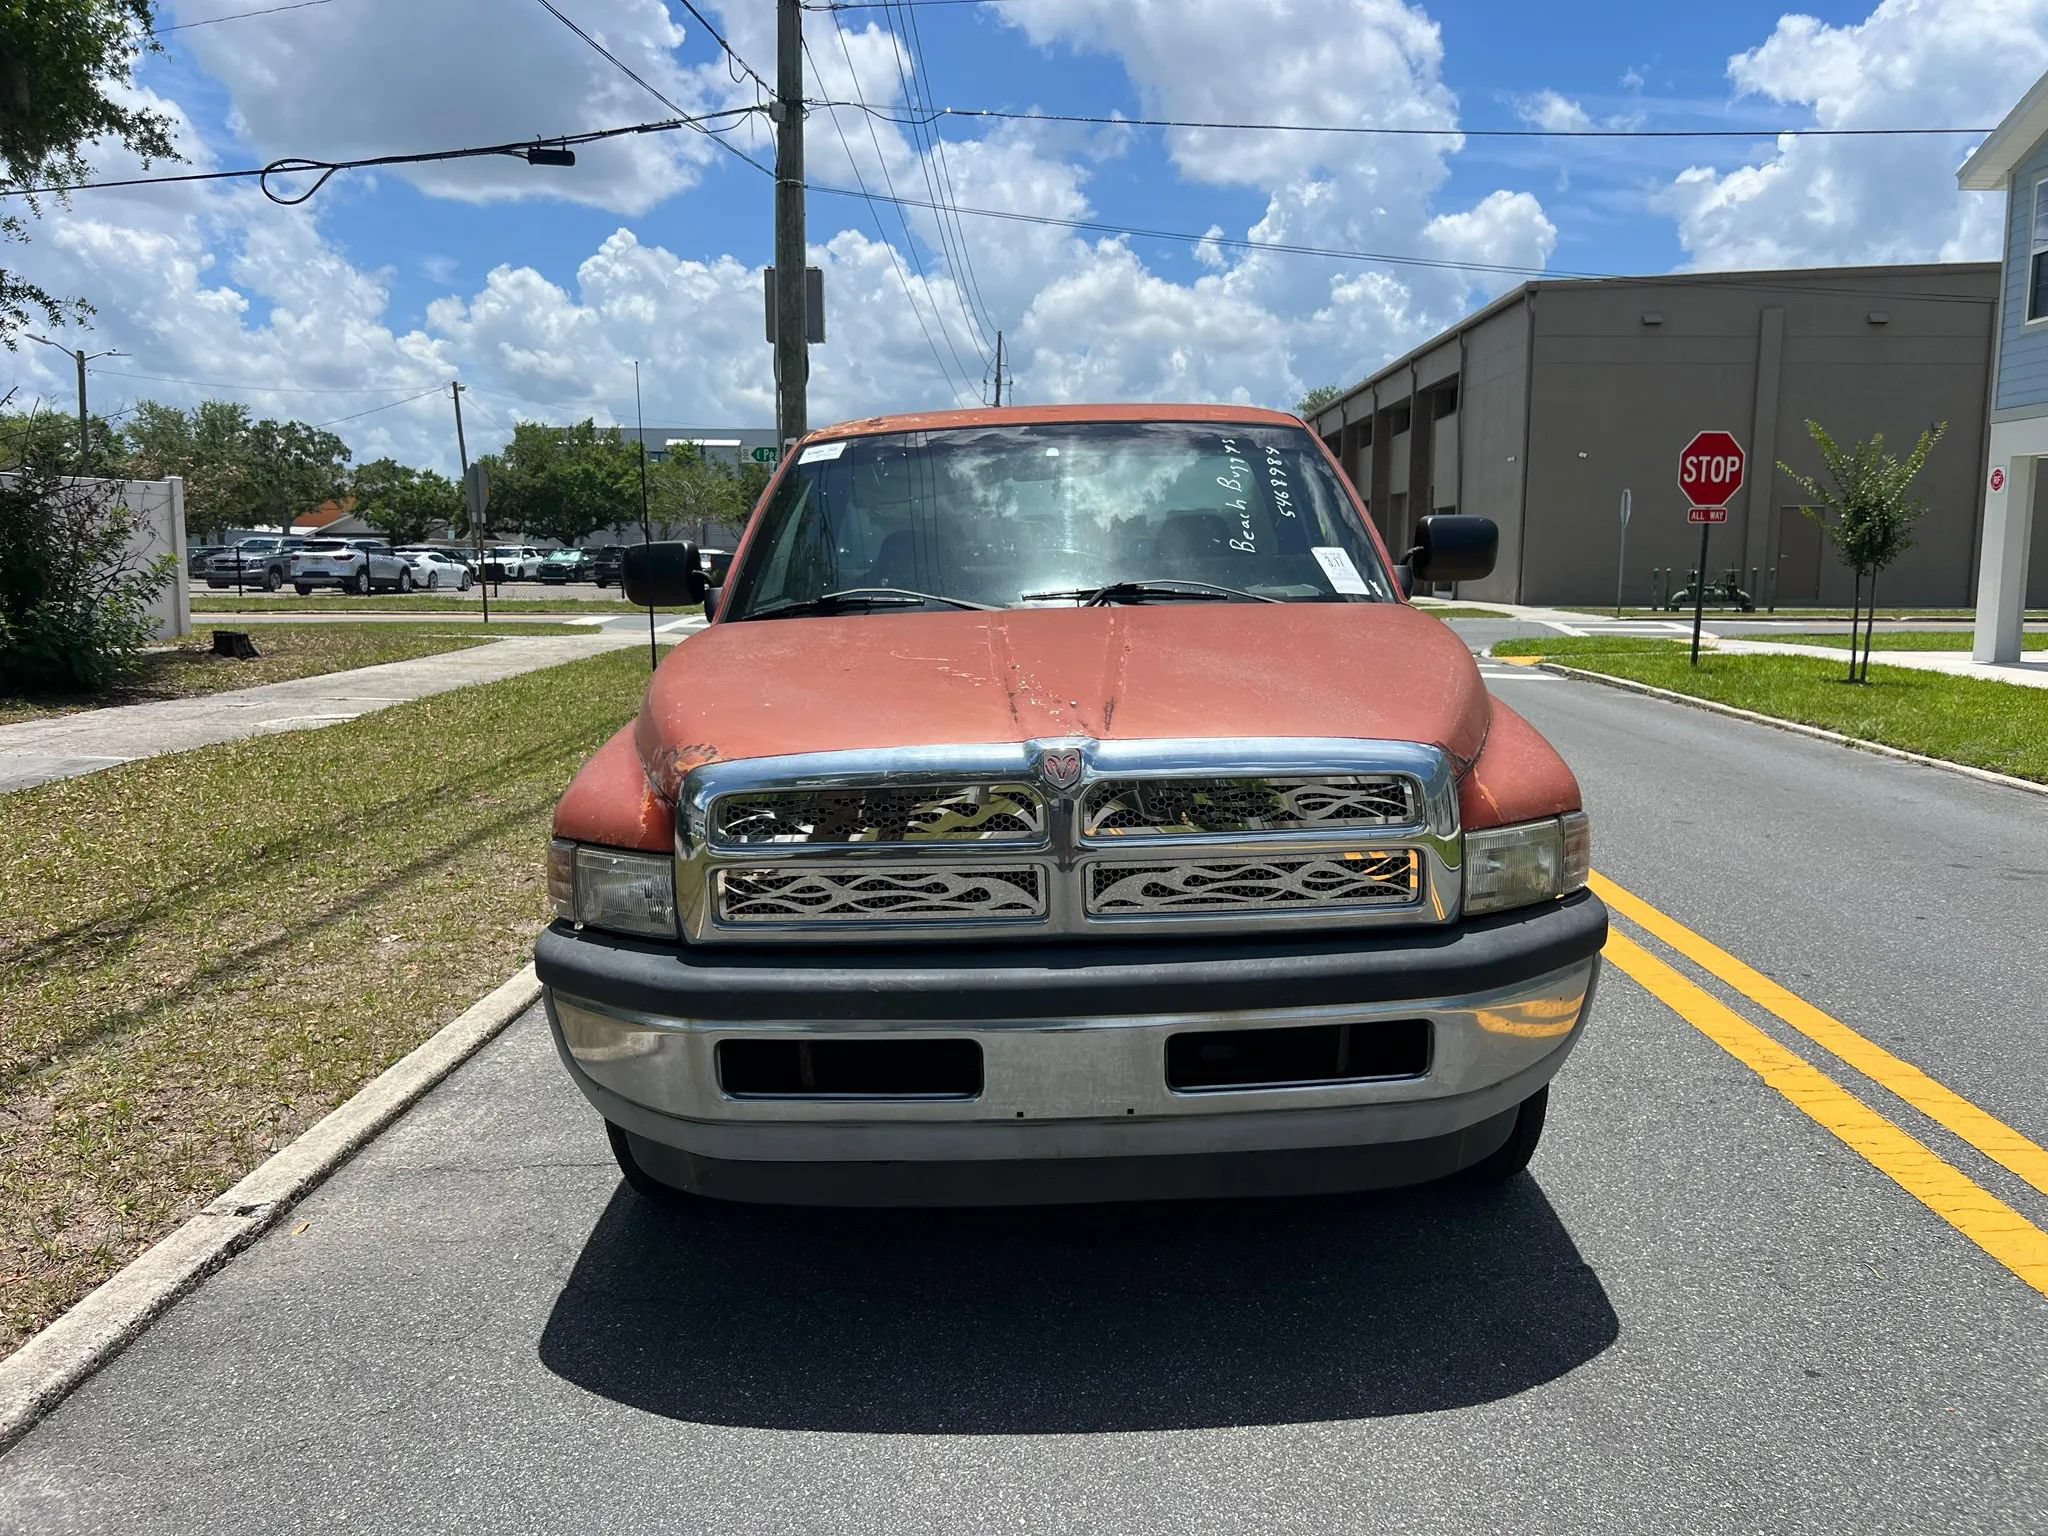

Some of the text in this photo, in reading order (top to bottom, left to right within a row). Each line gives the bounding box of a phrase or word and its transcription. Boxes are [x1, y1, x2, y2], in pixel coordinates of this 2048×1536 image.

[756, 450, 761, 459] E
[1683, 455, 1740, 483] STOP
[1691, 511, 1725, 520] ALL WAY
[1224, 499, 1256, 553] Beach
